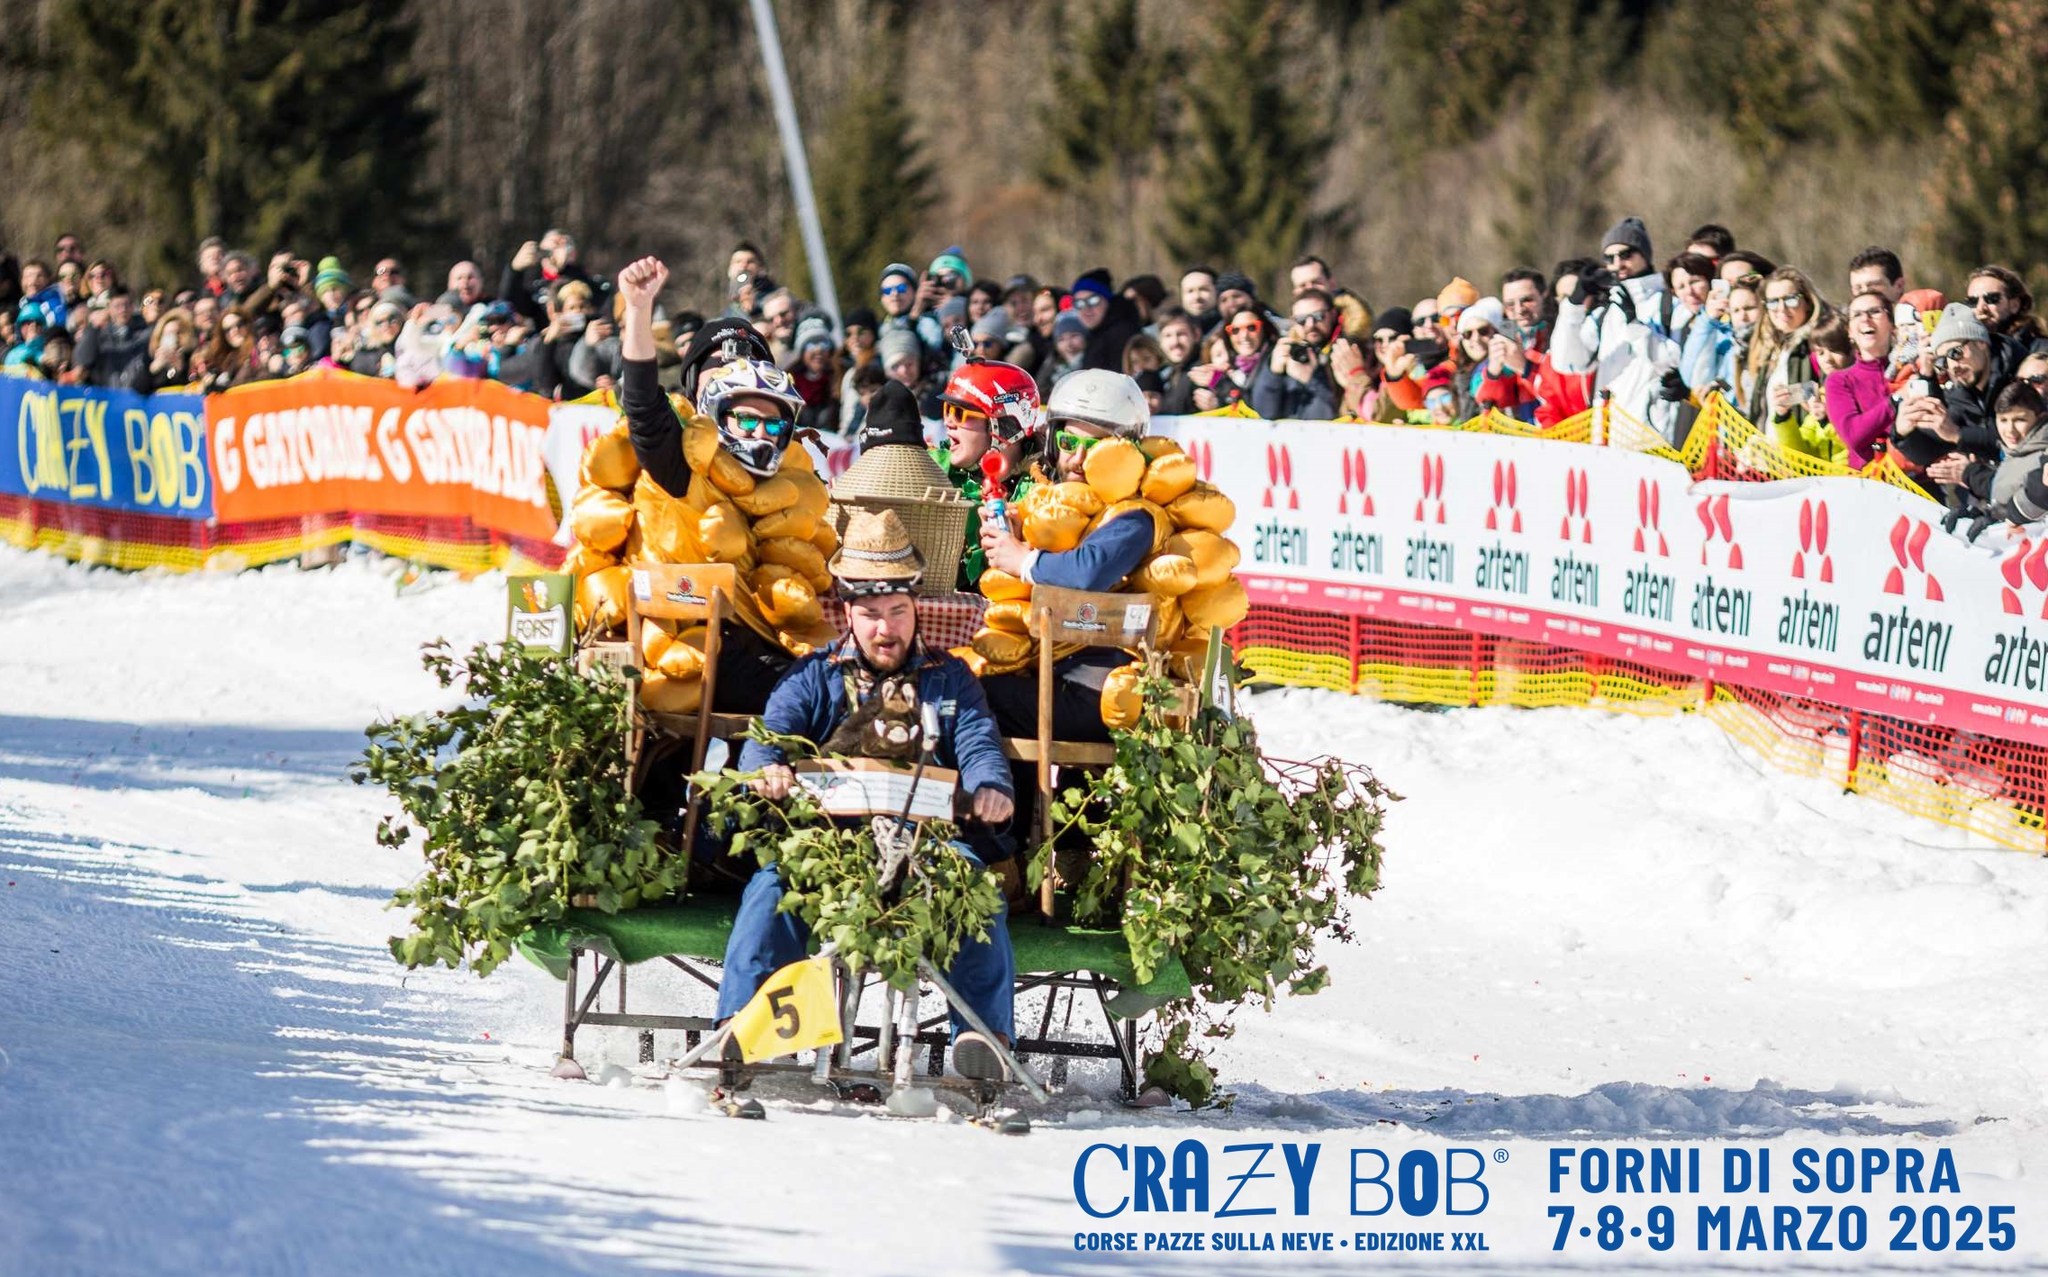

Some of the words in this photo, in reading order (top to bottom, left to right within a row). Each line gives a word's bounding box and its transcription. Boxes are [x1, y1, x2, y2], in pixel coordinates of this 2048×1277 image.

[404, 404, 547, 508] GATRADE
[516, 618, 557, 640] FORST
[1779, 589, 1839, 652] arteni
[1863, 605, 1952, 672] arteni
[766, 985, 800, 1039] 5
